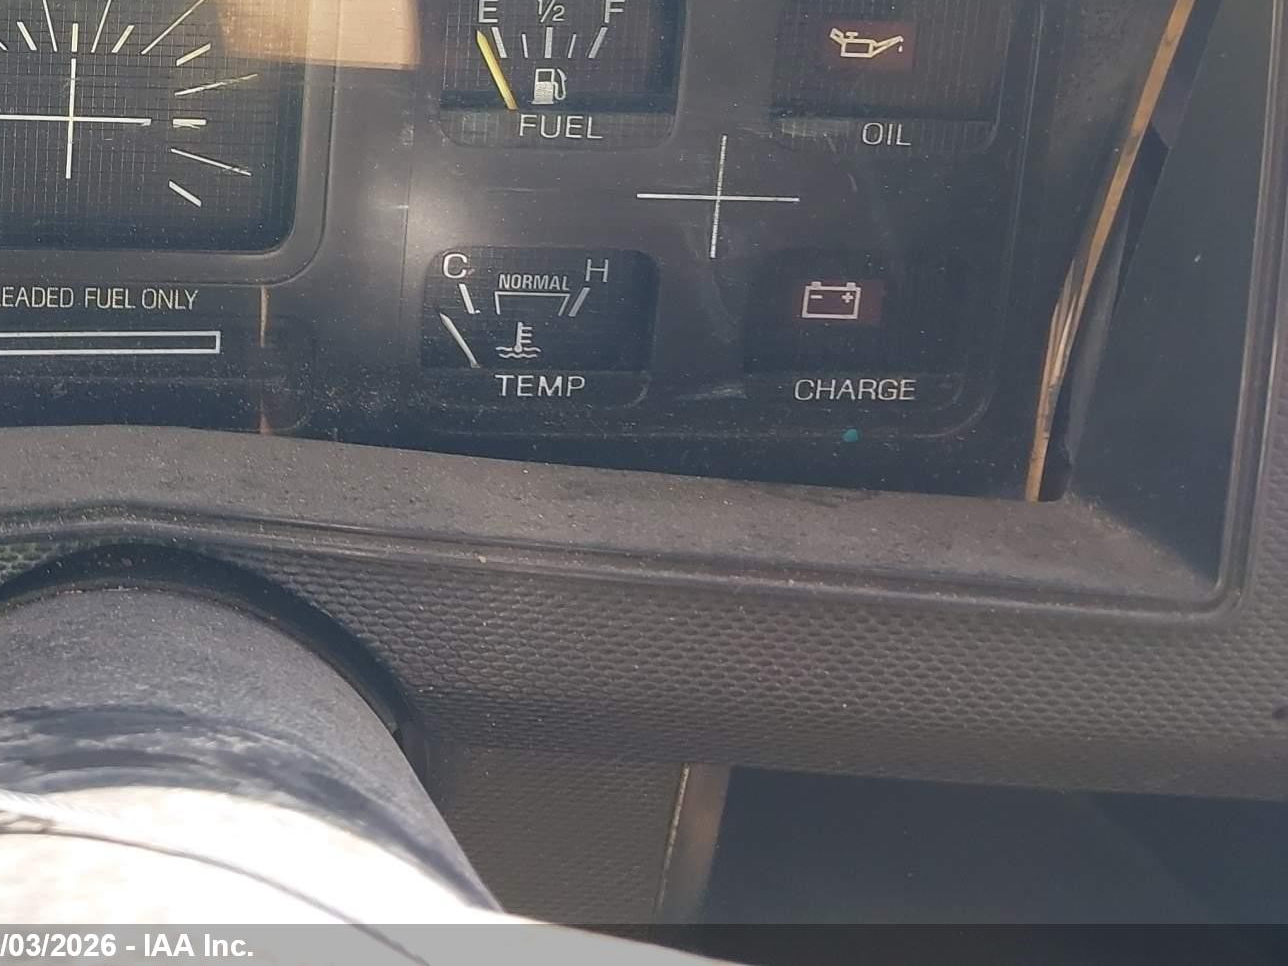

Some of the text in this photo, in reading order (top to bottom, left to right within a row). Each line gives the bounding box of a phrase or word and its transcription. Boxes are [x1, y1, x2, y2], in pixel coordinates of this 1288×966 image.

[519, 115, 603, 139] FUEL
[862, 123, 911, 146] OIL
[443, 254, 467, 279] C
[586, 259, 609, 283] H
[499, 273, 570, 291] NORMAL
[85, 288, 136, 309] FUEL
[142, 288, 198, 310] ONLY
[494, 375, 585, 398] TEMP
[794, 379, 916, 402] CHARGE
